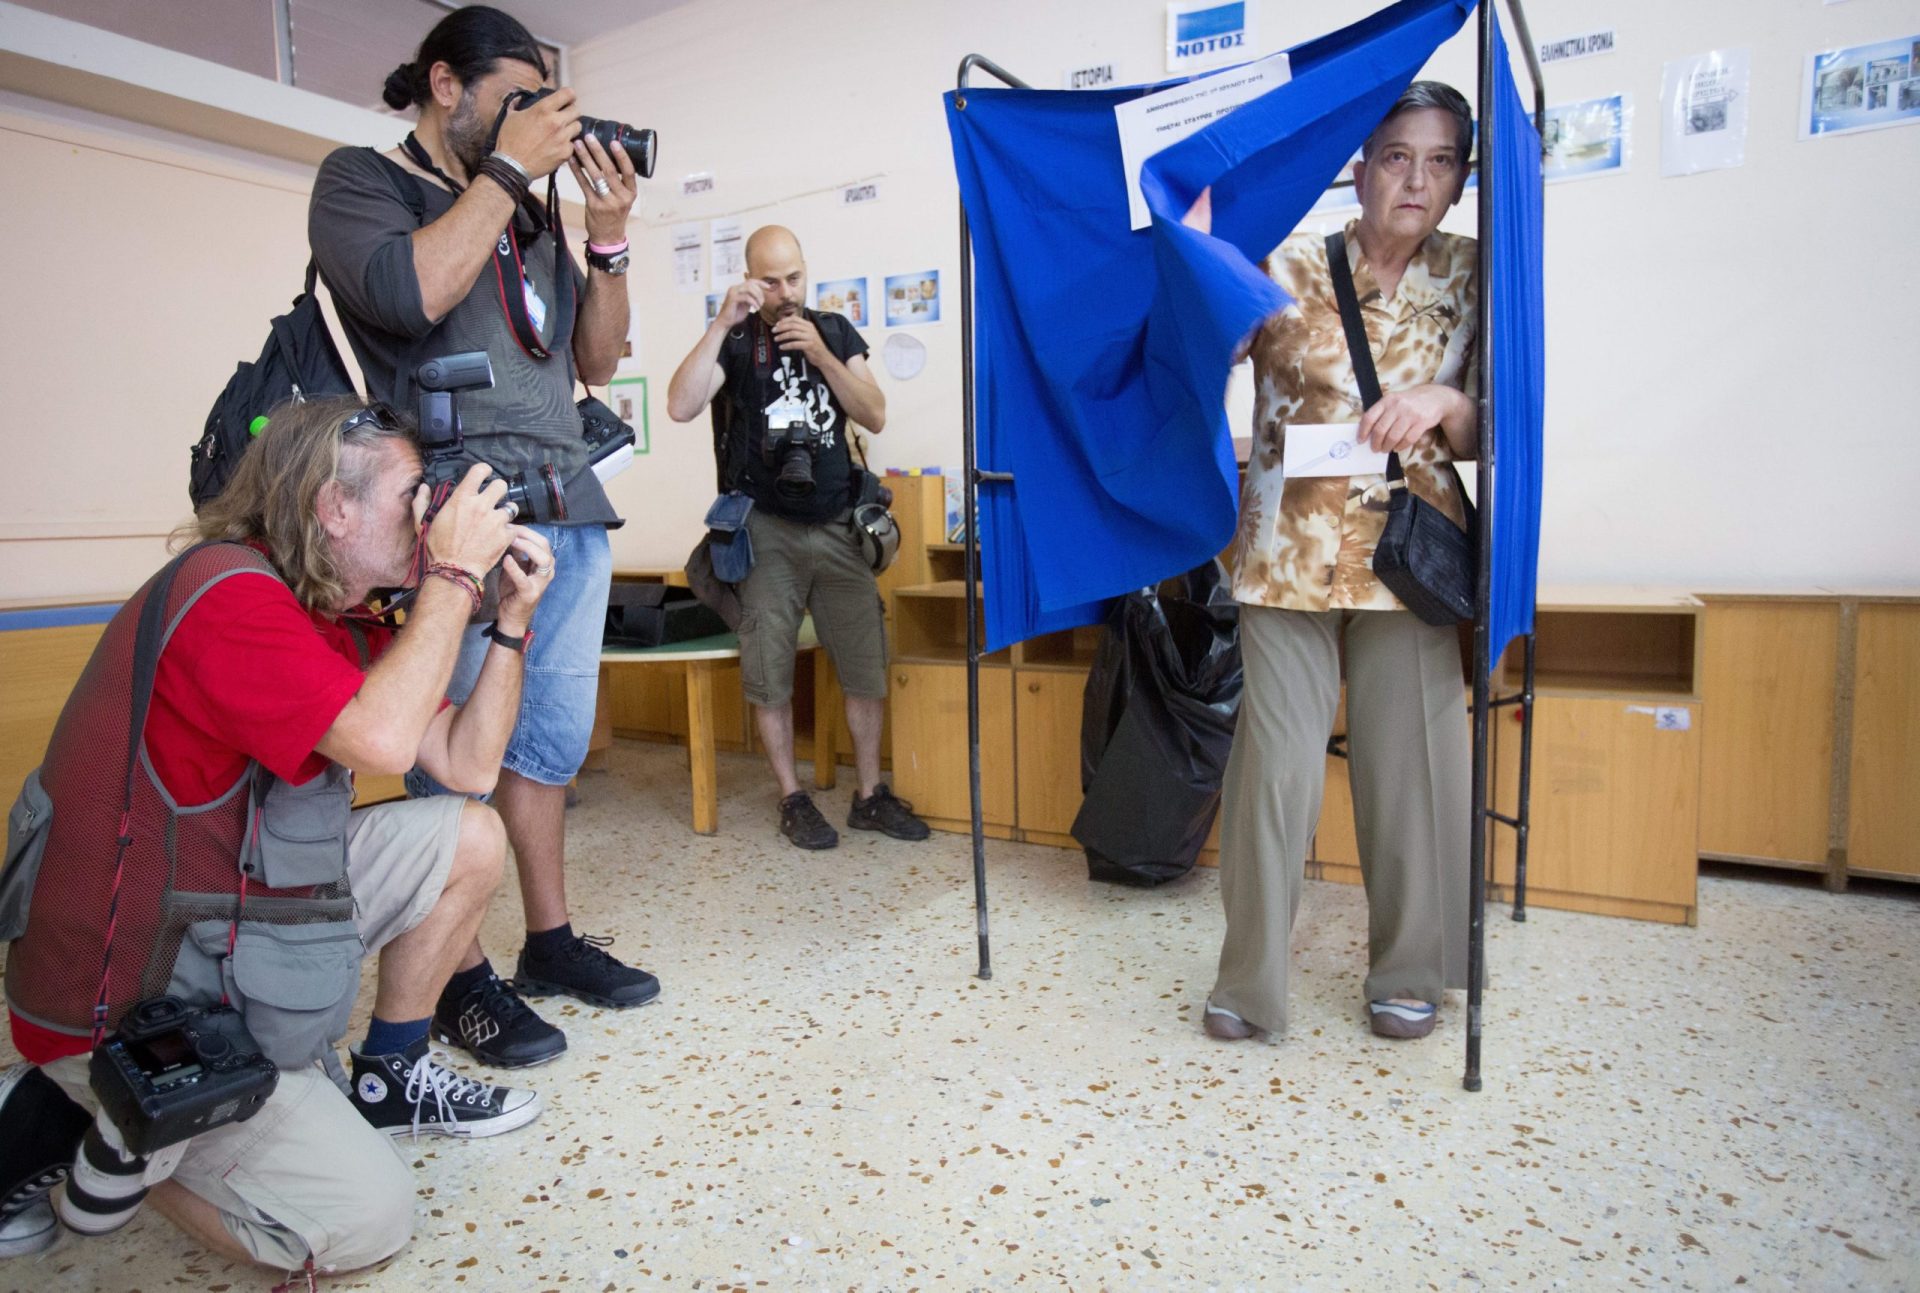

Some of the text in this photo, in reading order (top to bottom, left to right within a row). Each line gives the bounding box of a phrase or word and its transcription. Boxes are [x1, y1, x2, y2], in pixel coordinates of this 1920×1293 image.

[1176, 33, 1245, 58] ΝΟΤΟΣ
[1541, 31, 1613, 62] ΕΛΛΗΝΙΣΤΙΚΑ ΧΡΟΝΙΑ
[1071, 64, 1113, 89] ΙΣΤΟΡΙΑ
